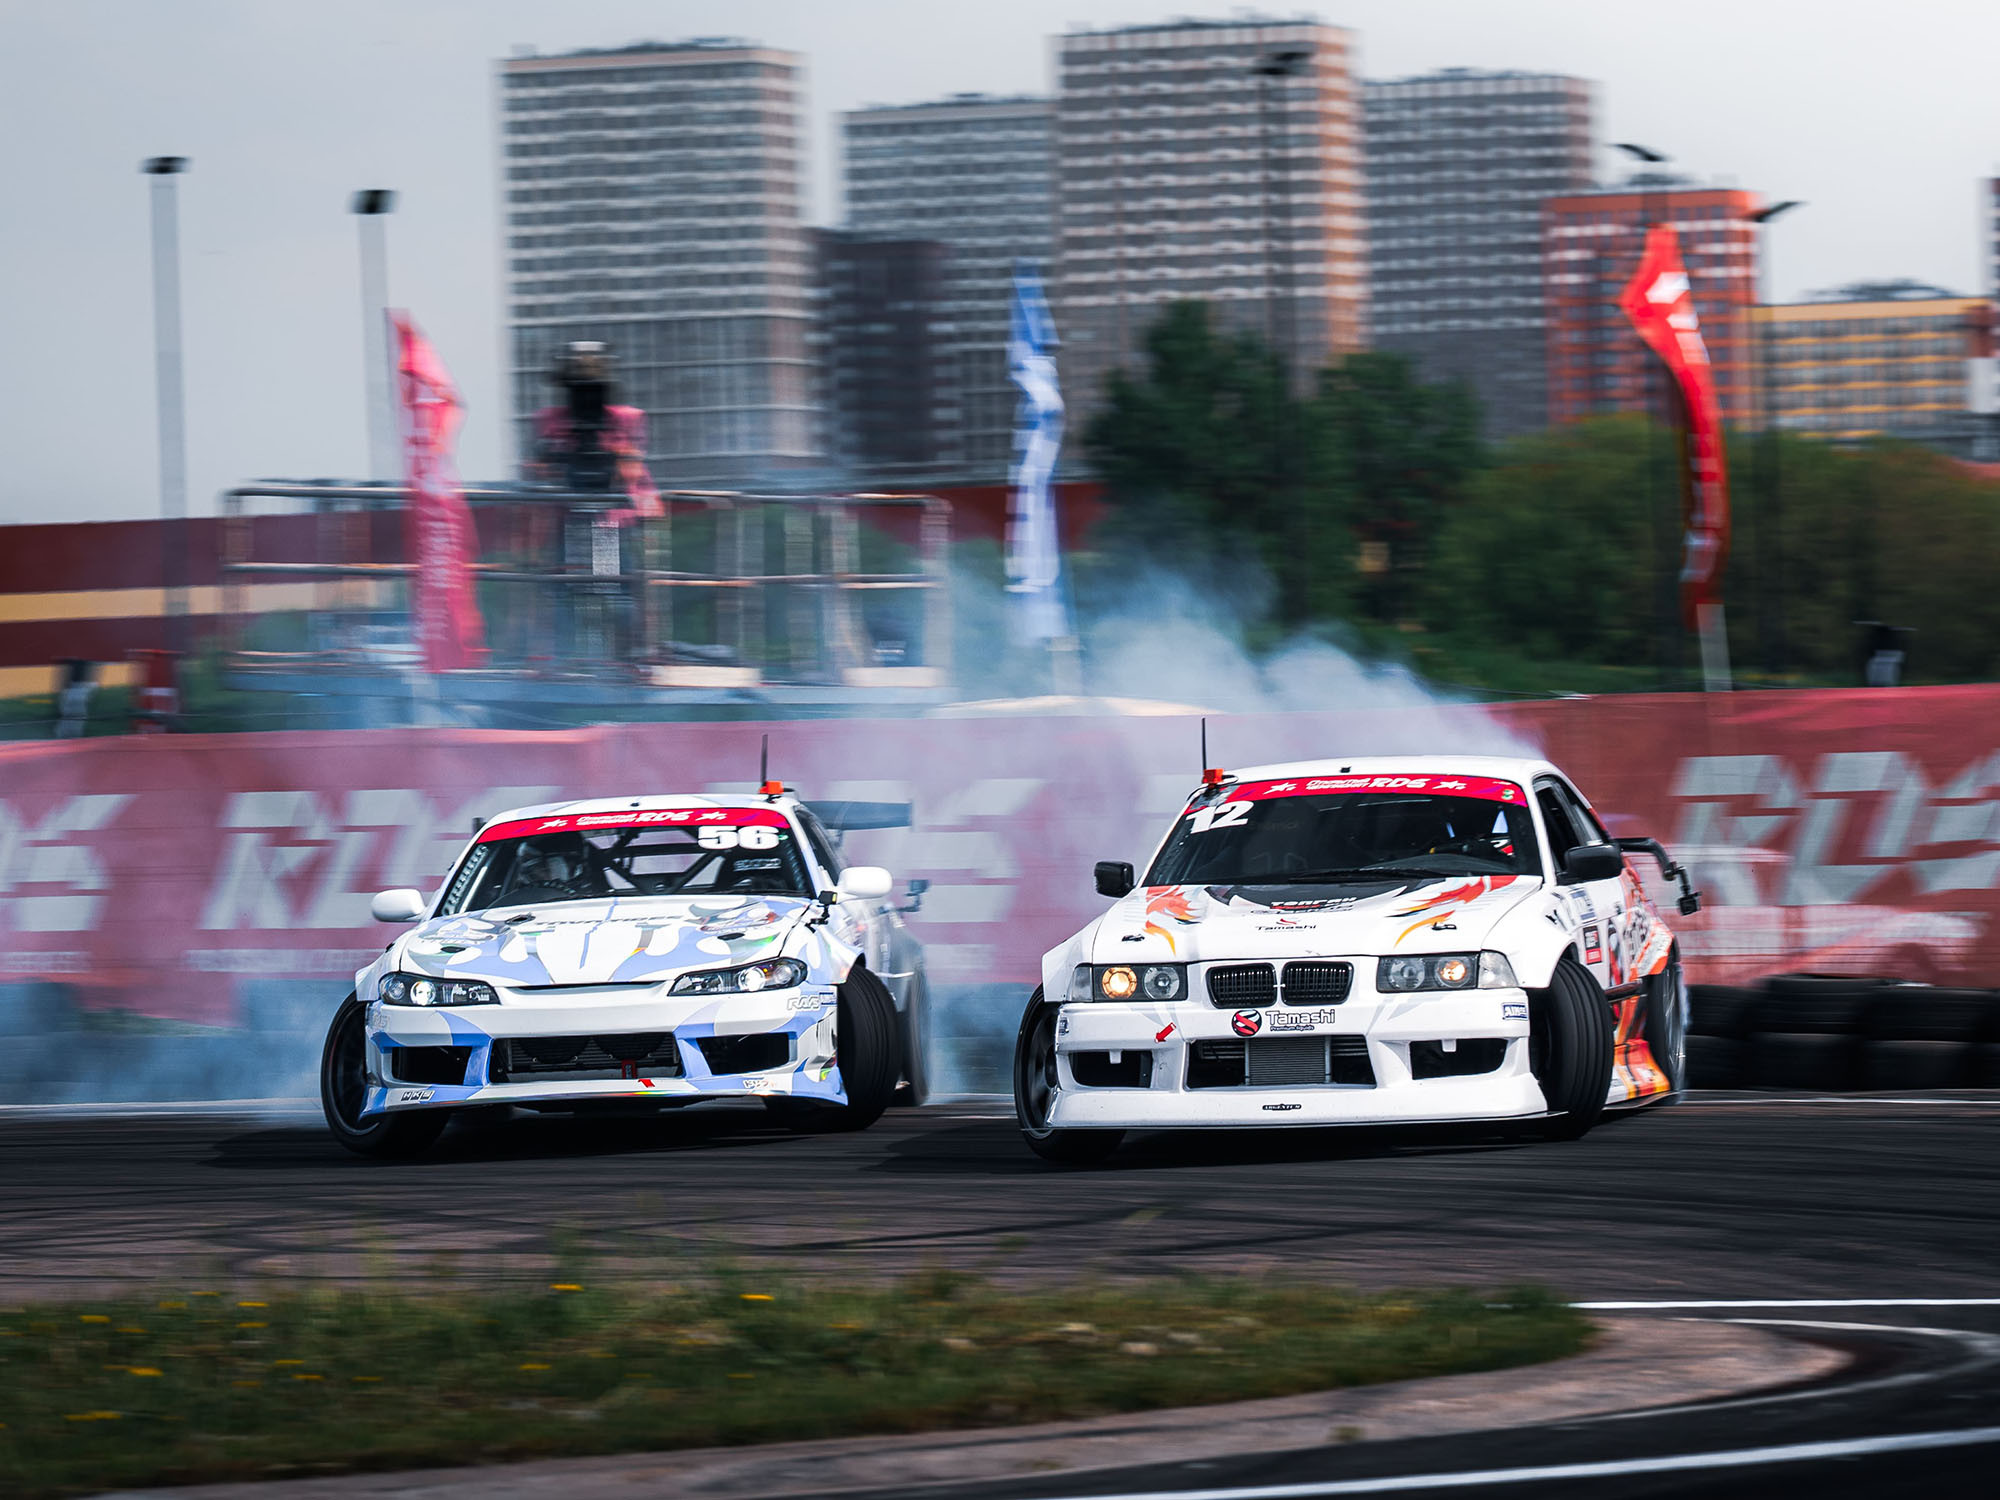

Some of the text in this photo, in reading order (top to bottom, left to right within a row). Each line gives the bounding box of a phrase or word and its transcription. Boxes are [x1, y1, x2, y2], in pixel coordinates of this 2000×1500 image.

[1368, 777, 1432, 789] RDS
[635, 810, 695, 824] RDS
[1186, 800, 1255, 833] 12
[698, 825, 780, 850] 56
[1266, 1009, 1335, 1025] Tamashi
